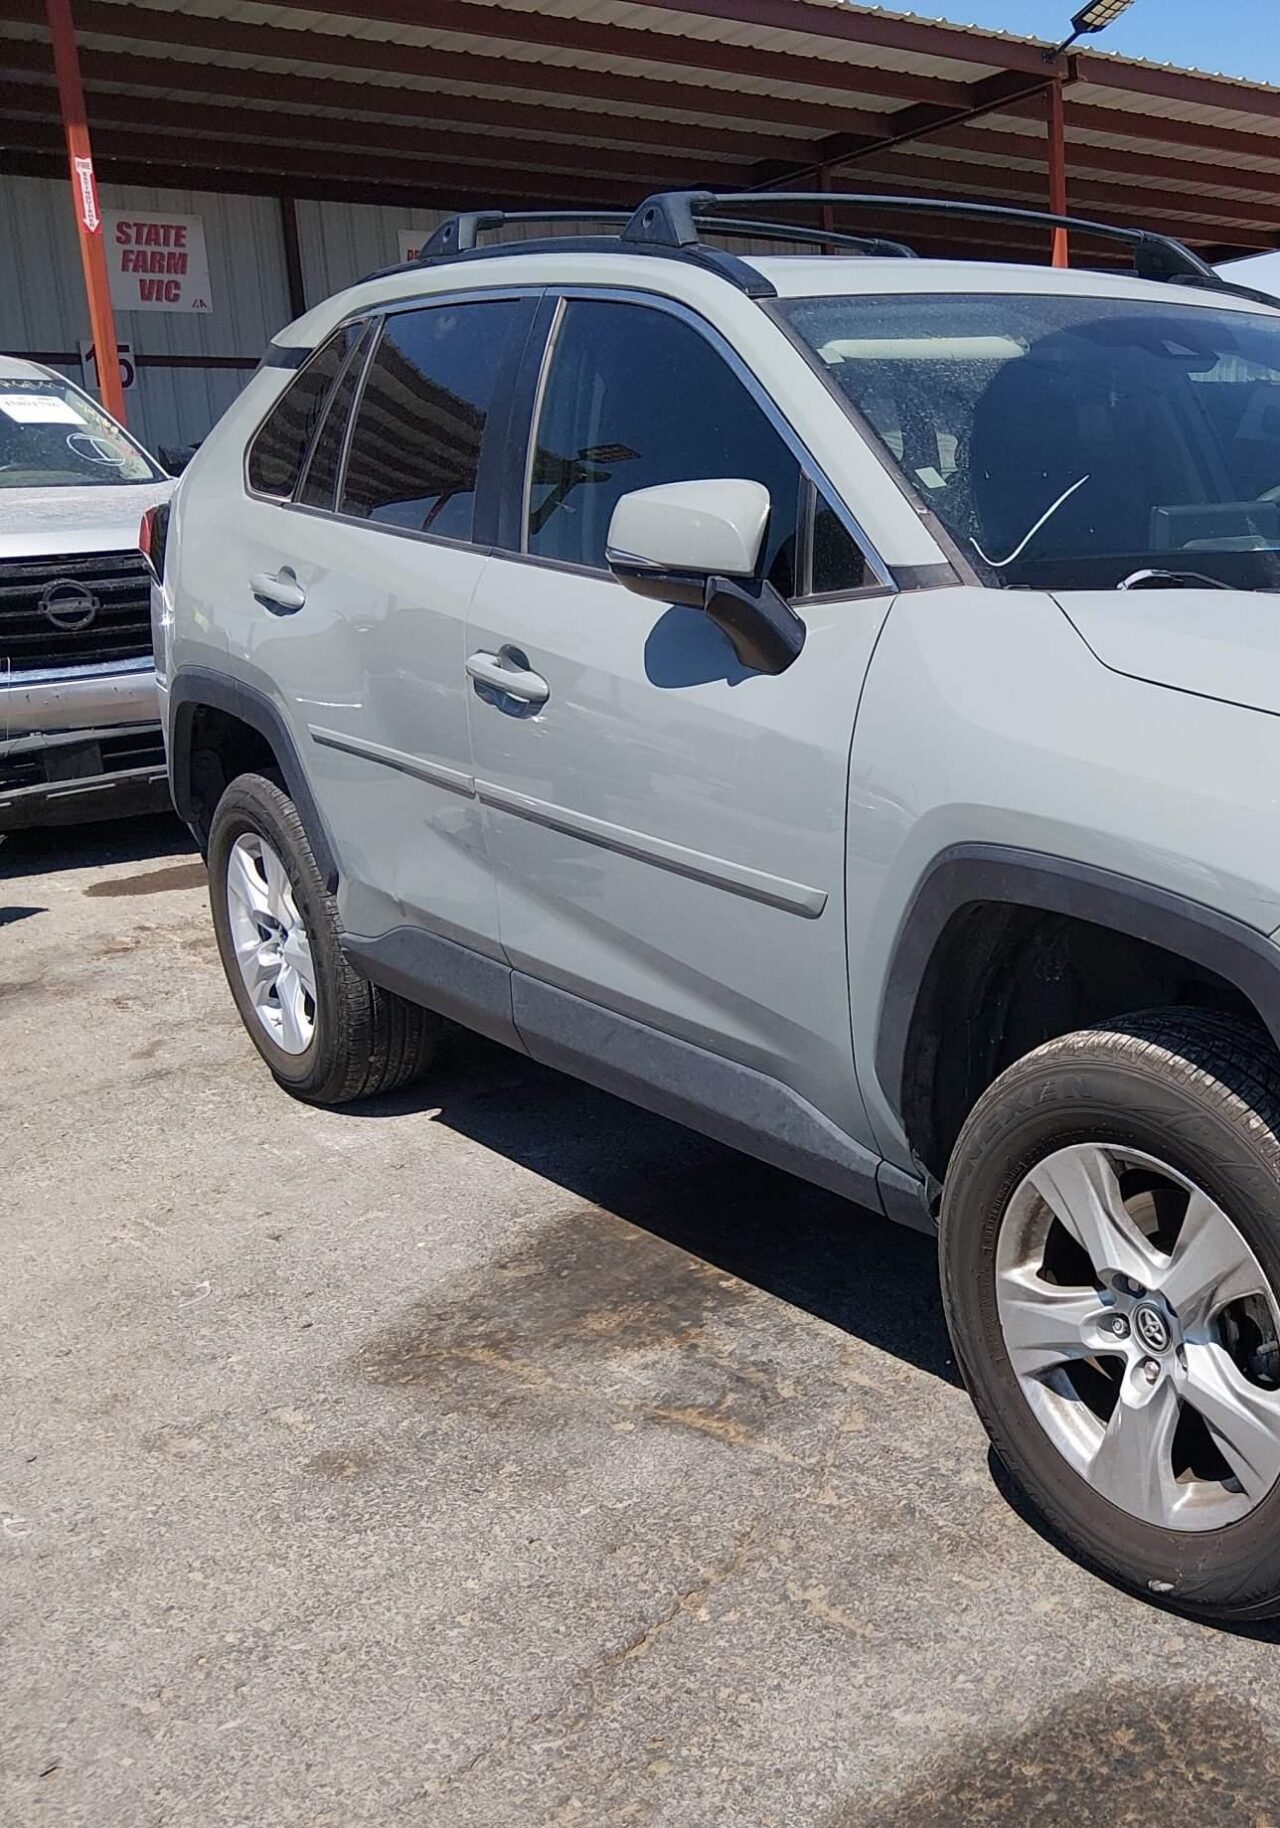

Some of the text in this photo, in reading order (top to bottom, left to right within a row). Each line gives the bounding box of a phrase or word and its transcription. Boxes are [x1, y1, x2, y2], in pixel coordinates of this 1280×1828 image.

[115, 221, 187, 248] STATE
[120, 249, 189, 276] FARM
[138, 278, 182, 303] VIC
